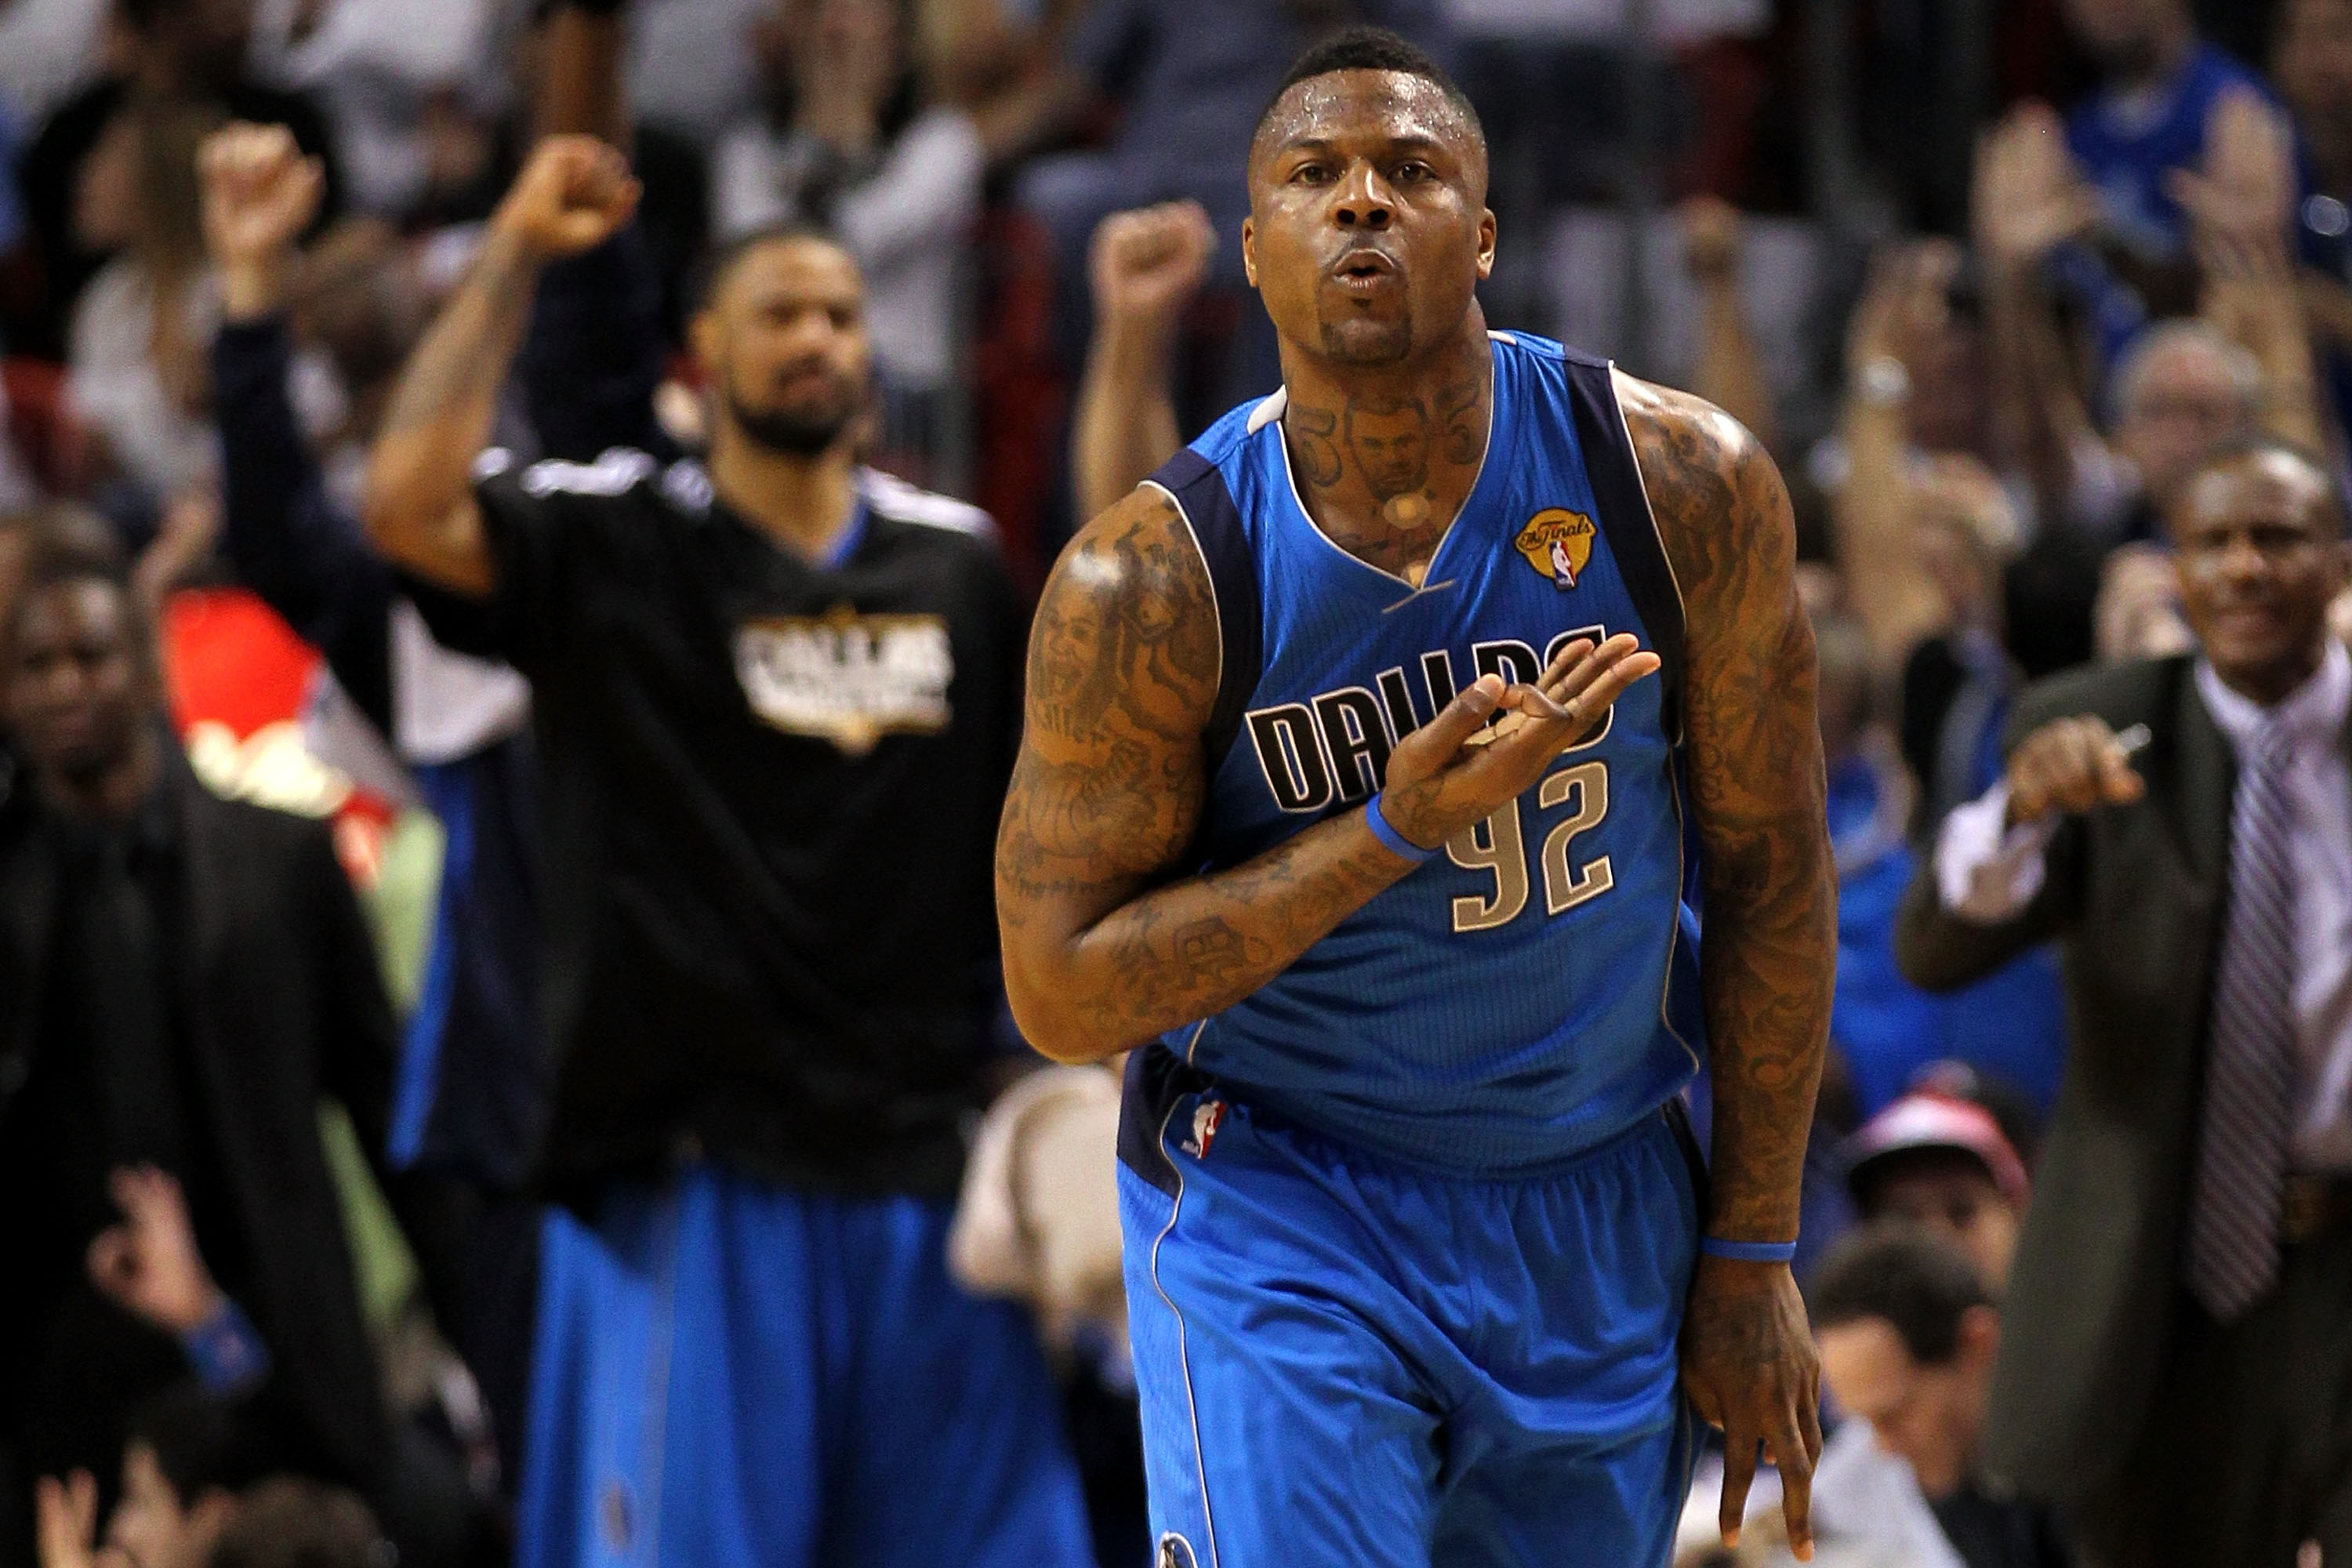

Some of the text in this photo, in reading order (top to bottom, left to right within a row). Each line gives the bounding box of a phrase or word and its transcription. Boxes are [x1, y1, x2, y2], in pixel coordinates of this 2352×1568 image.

[1534, 515, 1591, 548] Finals
[1245, 625, 1614, 813] DAAS
[1445, 760, 1614, 933] 92
